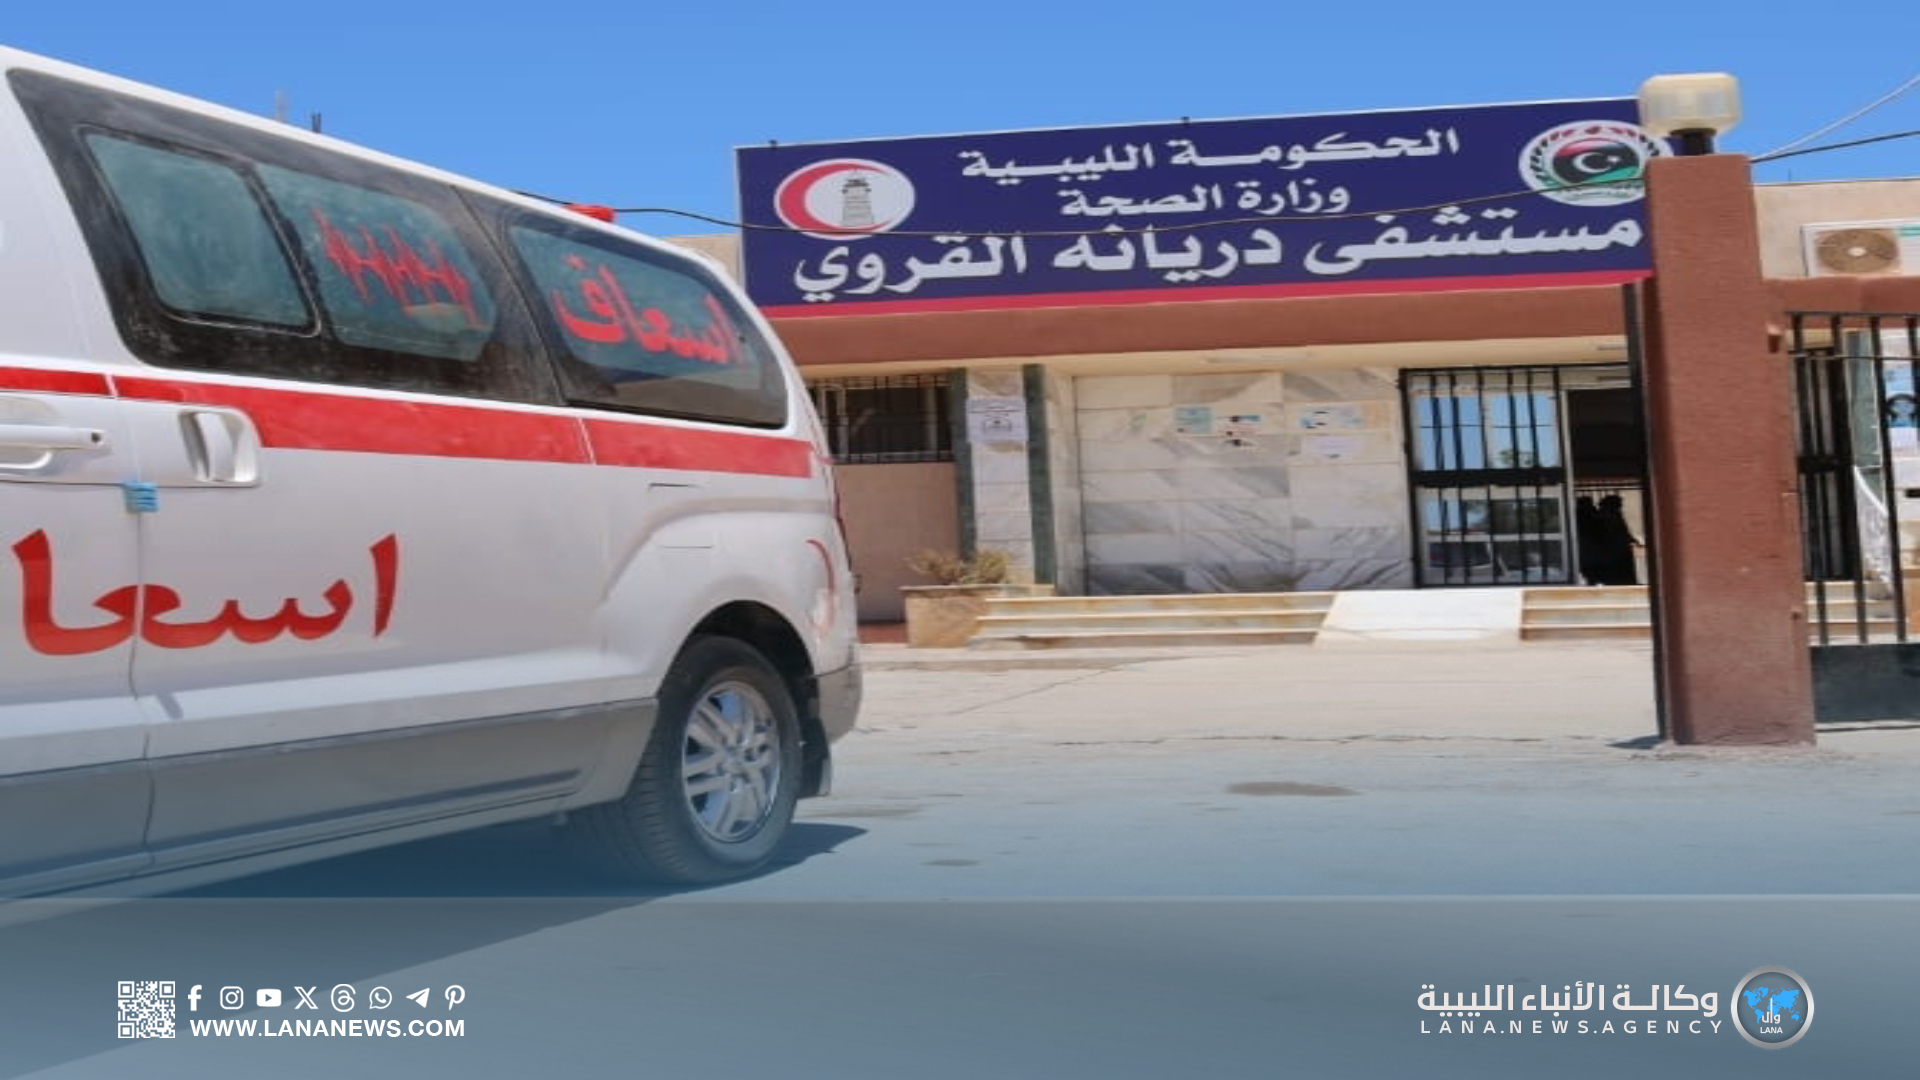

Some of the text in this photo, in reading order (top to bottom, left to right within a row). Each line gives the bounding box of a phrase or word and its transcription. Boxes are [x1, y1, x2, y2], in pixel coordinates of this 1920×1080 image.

[957, 125, 1460, 185] الحكومة الليبية
[1056, 177, 1350, 217] وزارة الصحة
[793, 232, 1028, 303] القروي
[1303, 205, 1643, 275] مستشفى
